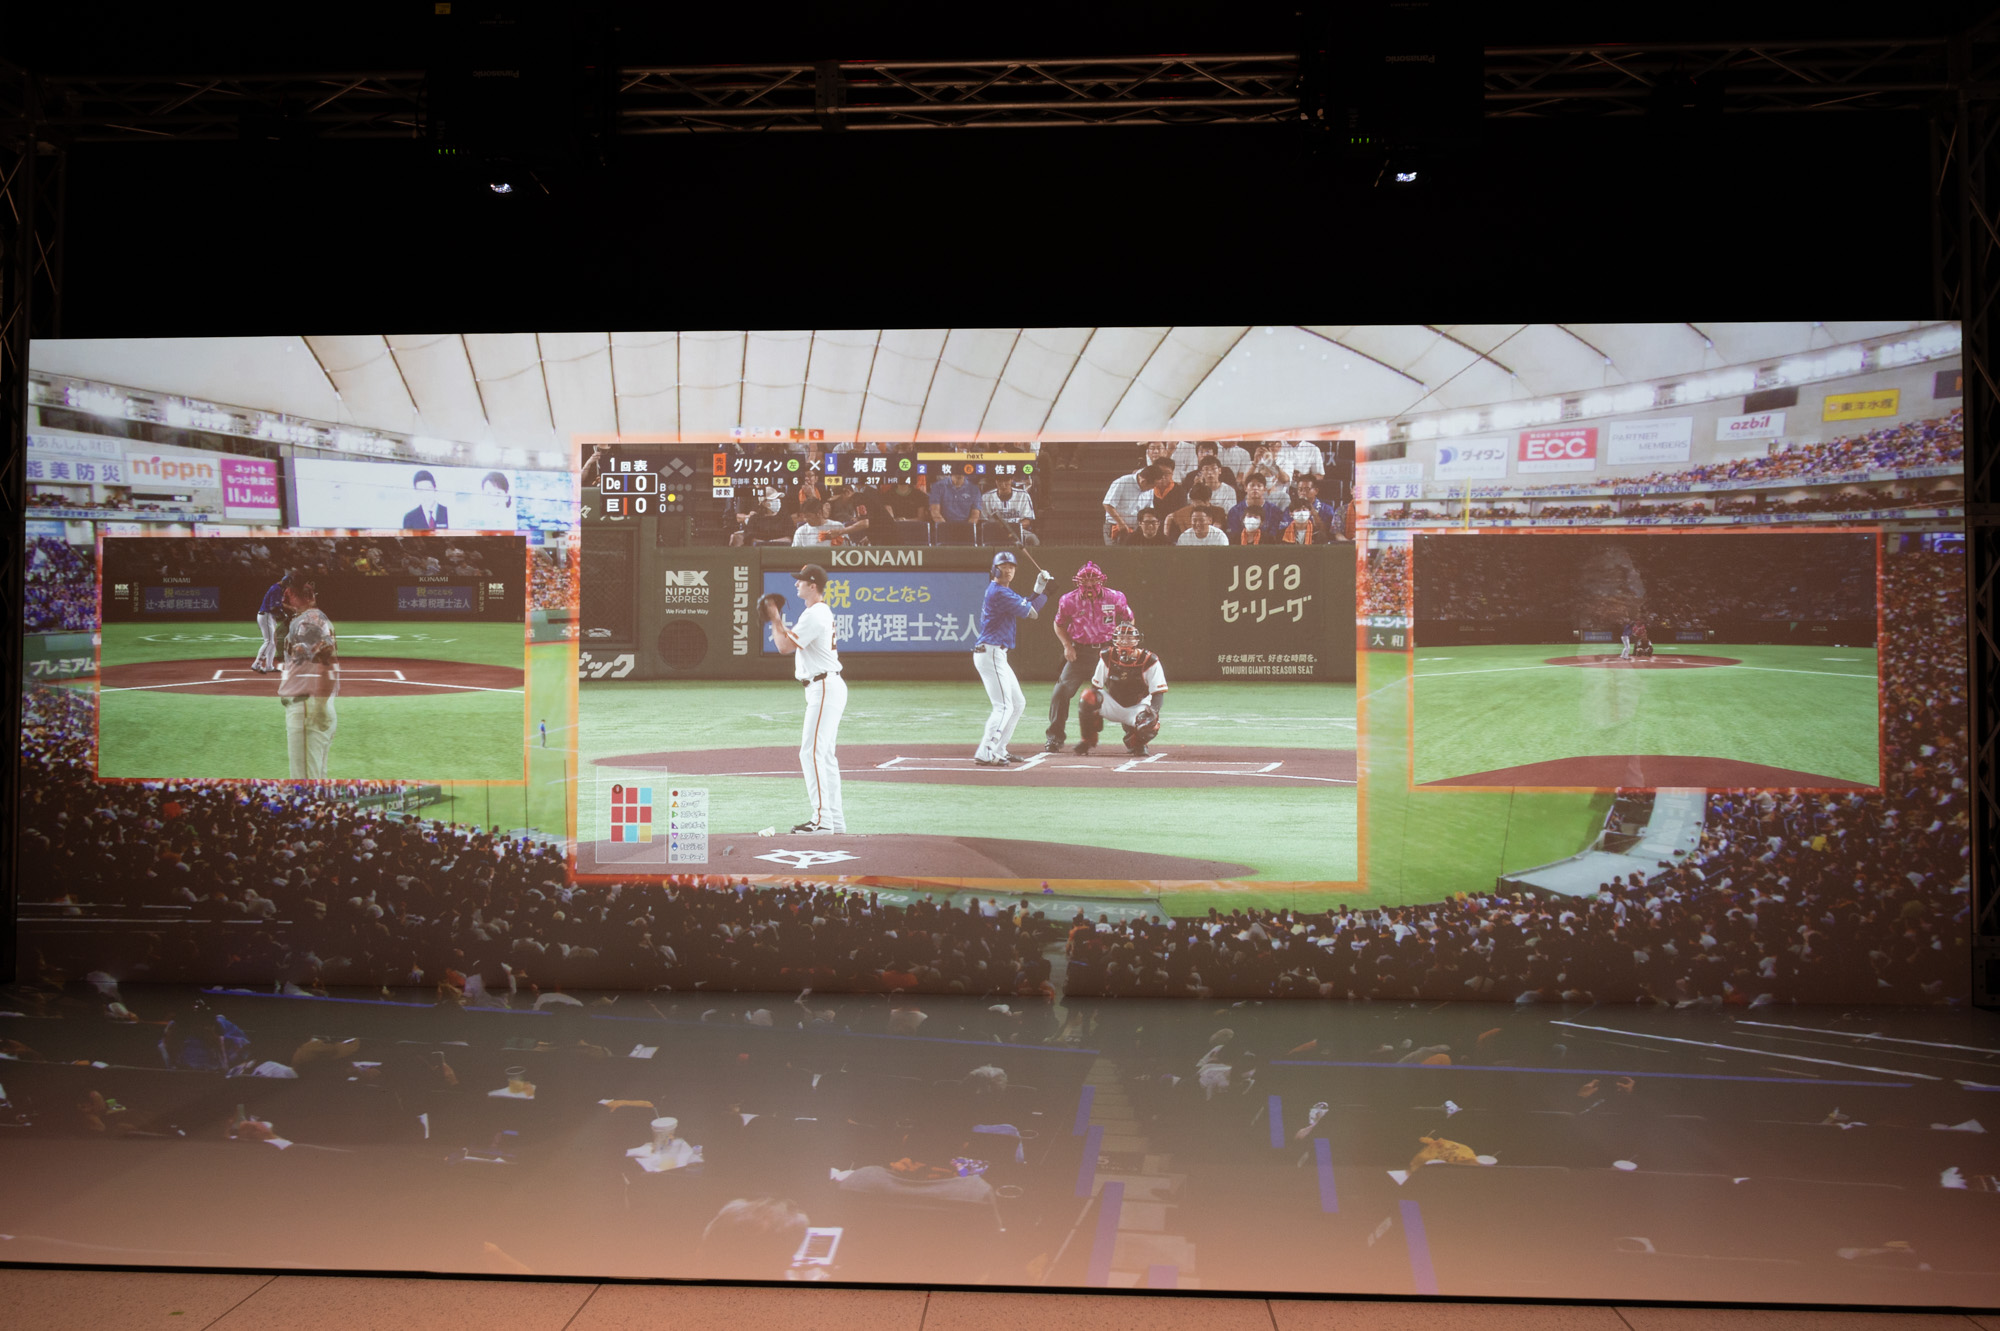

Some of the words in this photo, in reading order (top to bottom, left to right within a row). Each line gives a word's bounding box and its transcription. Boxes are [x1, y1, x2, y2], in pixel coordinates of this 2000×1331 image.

[1384, 55, 1435, 64] Panasonic
[472, 69, 520, 79] Panasonic
[1730, 415, 1771, 430] azbil
[1612, 432, 1658, 442] PARTNER
[1527, 437, 1587, 459] ECC
[1638, 440, 1688, 450] MEMBERS
[1461, 449, 1505, 461] ダイタン
[132, 456, 214, 480] nippn
[733, 458, 783, 473] グリフィン
[852, 457, 887, 473] 梶原
[918, 465, 926, 474] 2
[941, 464, 952, 474] 牧
[977, 465, 984, 473] 3
[994, 464, 1017, 475] 佐野
[605, 476, 621, 490] De
[635, 475, 647, 492] 0
[753, 477, 769, 486] 3.10
[792, 477, 798, 485] 6
[865, 476, 880, 485] .317
[905, 476, 911, 484] 4
[660, 483, 667, 492] B
[660, 493, 667, 502] S
[606, 498, 620, 512] 巨
[635, 497, 647, 513] 0
[831, 550, 923, 567] KONAMI
[665, 570, 709, 586] NX
[665, 587, 709, 596] NIPPON
[665, 596, 709, 604] EXPRESS
[697, 608, 709, 616] Way
[733, 566, 749, 655] ビックカメラ
[1221, 595, 1312, 623] セ・リーグ
[1221, 666, 1248, 675] YOMIURI
[1248, 666, 1271, 675] GIANTS
[1271, 666, 1297, 675] SEASON
[1297, 666, 1313, 674] SEAT
